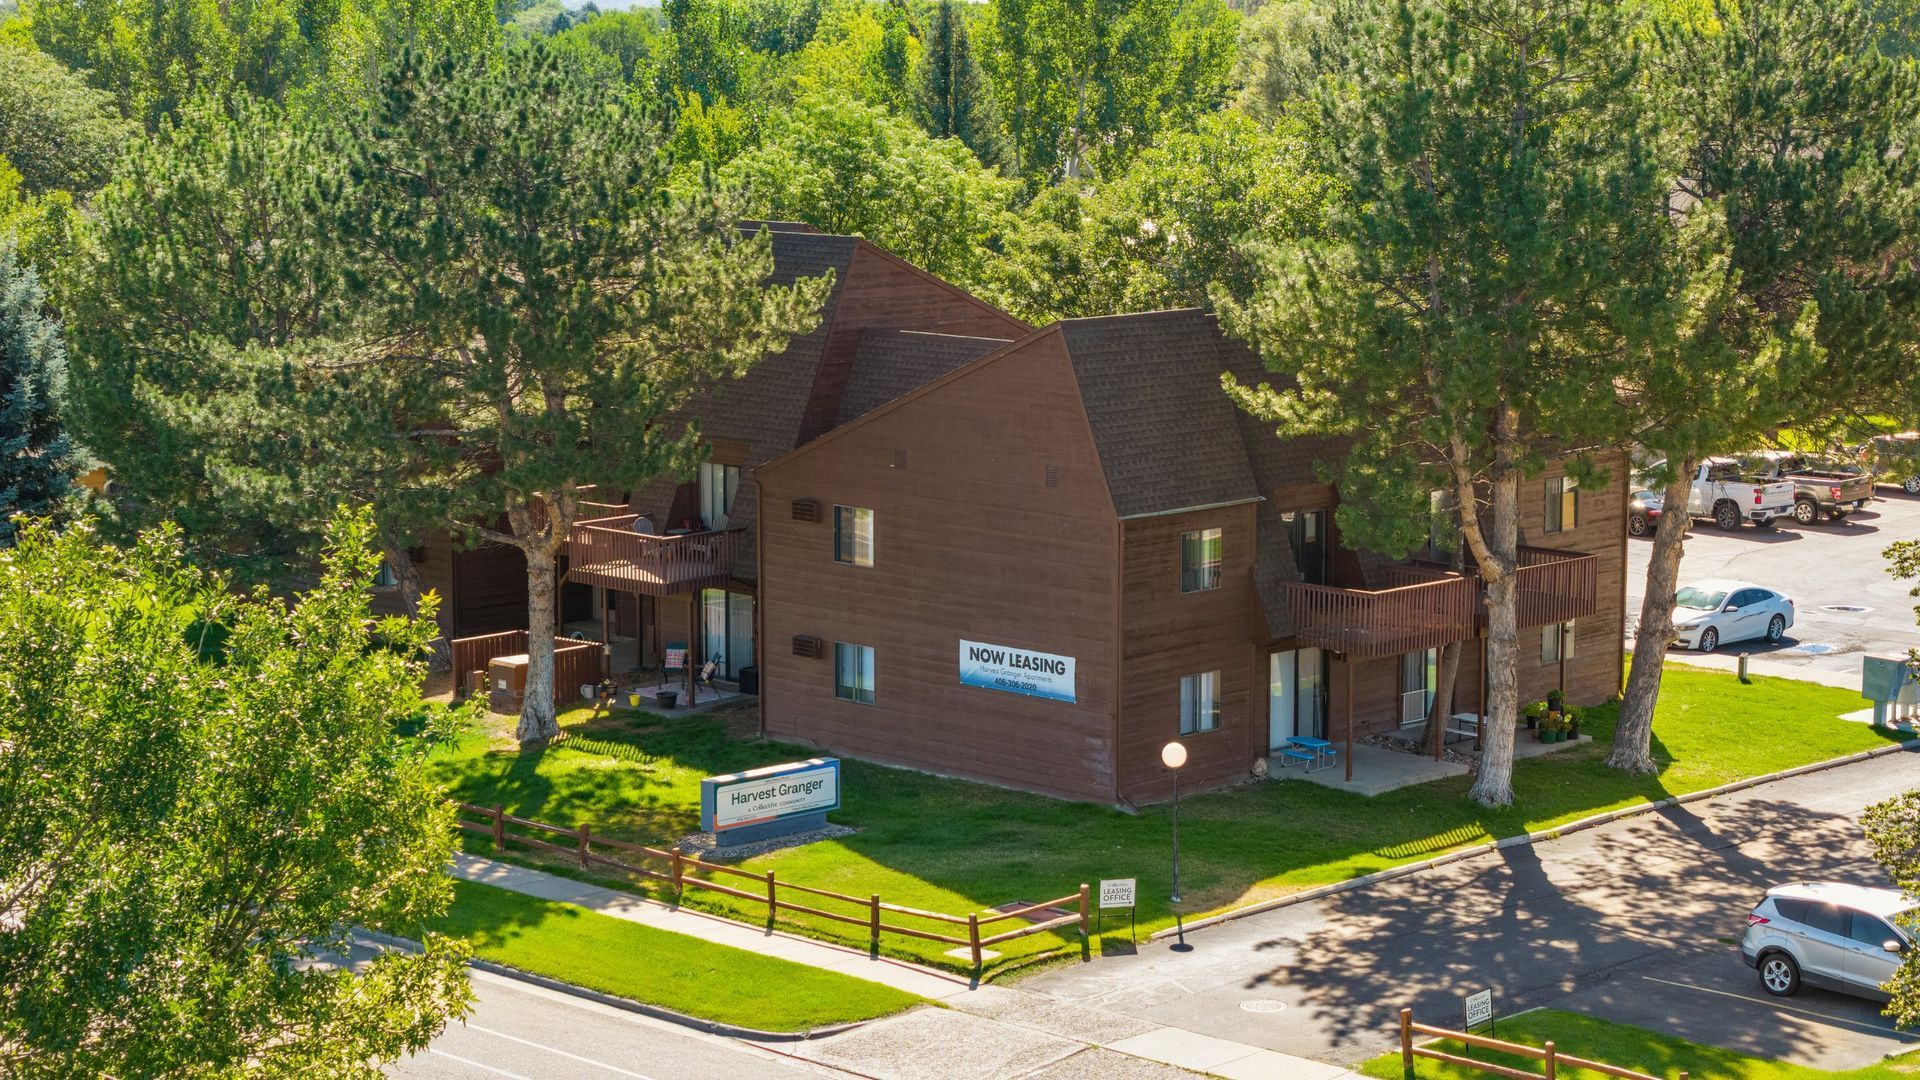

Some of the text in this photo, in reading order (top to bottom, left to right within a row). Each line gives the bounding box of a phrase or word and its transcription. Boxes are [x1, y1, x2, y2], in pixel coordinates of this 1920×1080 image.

[969, 646, 1066, 676] NOW LEASING
[980, 664, 1053, 684] Harvest Granger Apartments
[731, 786, 777, 806] Harvest
[778, 779, 824, 795] Granger
[752, 801, 778, 812] Collective
[779, 797, 806, 807] COMMUNITY
[1103, 887, 1132, 895] LEASING
[1467, 999, 1490, 1012] LEASING
[1467, 1006, 1489, 1019] OFFICE
